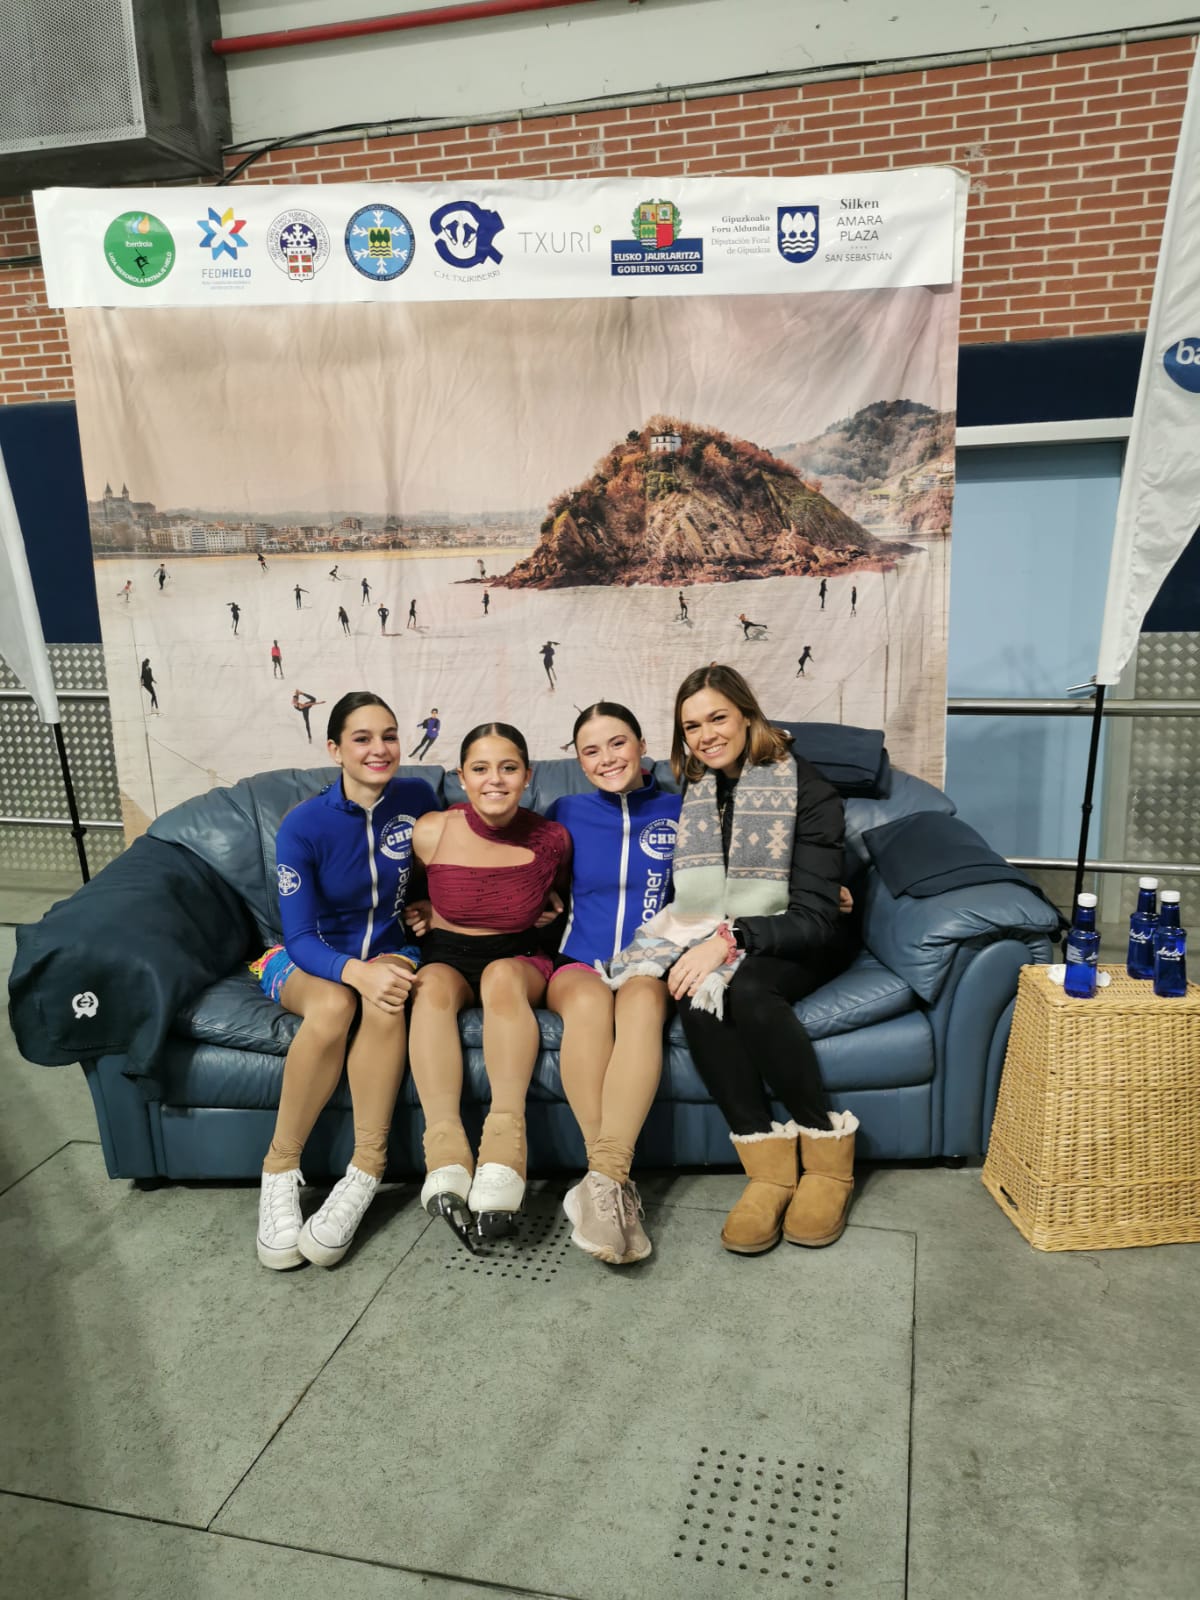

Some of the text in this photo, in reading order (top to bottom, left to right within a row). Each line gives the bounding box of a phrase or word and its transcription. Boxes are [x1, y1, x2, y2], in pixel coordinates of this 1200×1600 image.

[840, 198, 879, 210] Silken
[721, 214, 770, 224] Gipuzkoako
[836, 215, 883, 227] AMARA
[711, 224, 770, 233] Foru Aldundia
[840, 230, 879, 241] PLAZA
[518, 231, 591, 254] TXURI
[614, 251, 701, 262] EUSKO JAURLARITZA
[825, 252, 892, 262] SAN SEBASTIÁN
[201, 268, 252, 279] FEDHIELO
[617, 263, 698, 274] GOBIERNO VASCO
[649, 833, 676, 845] CHH
